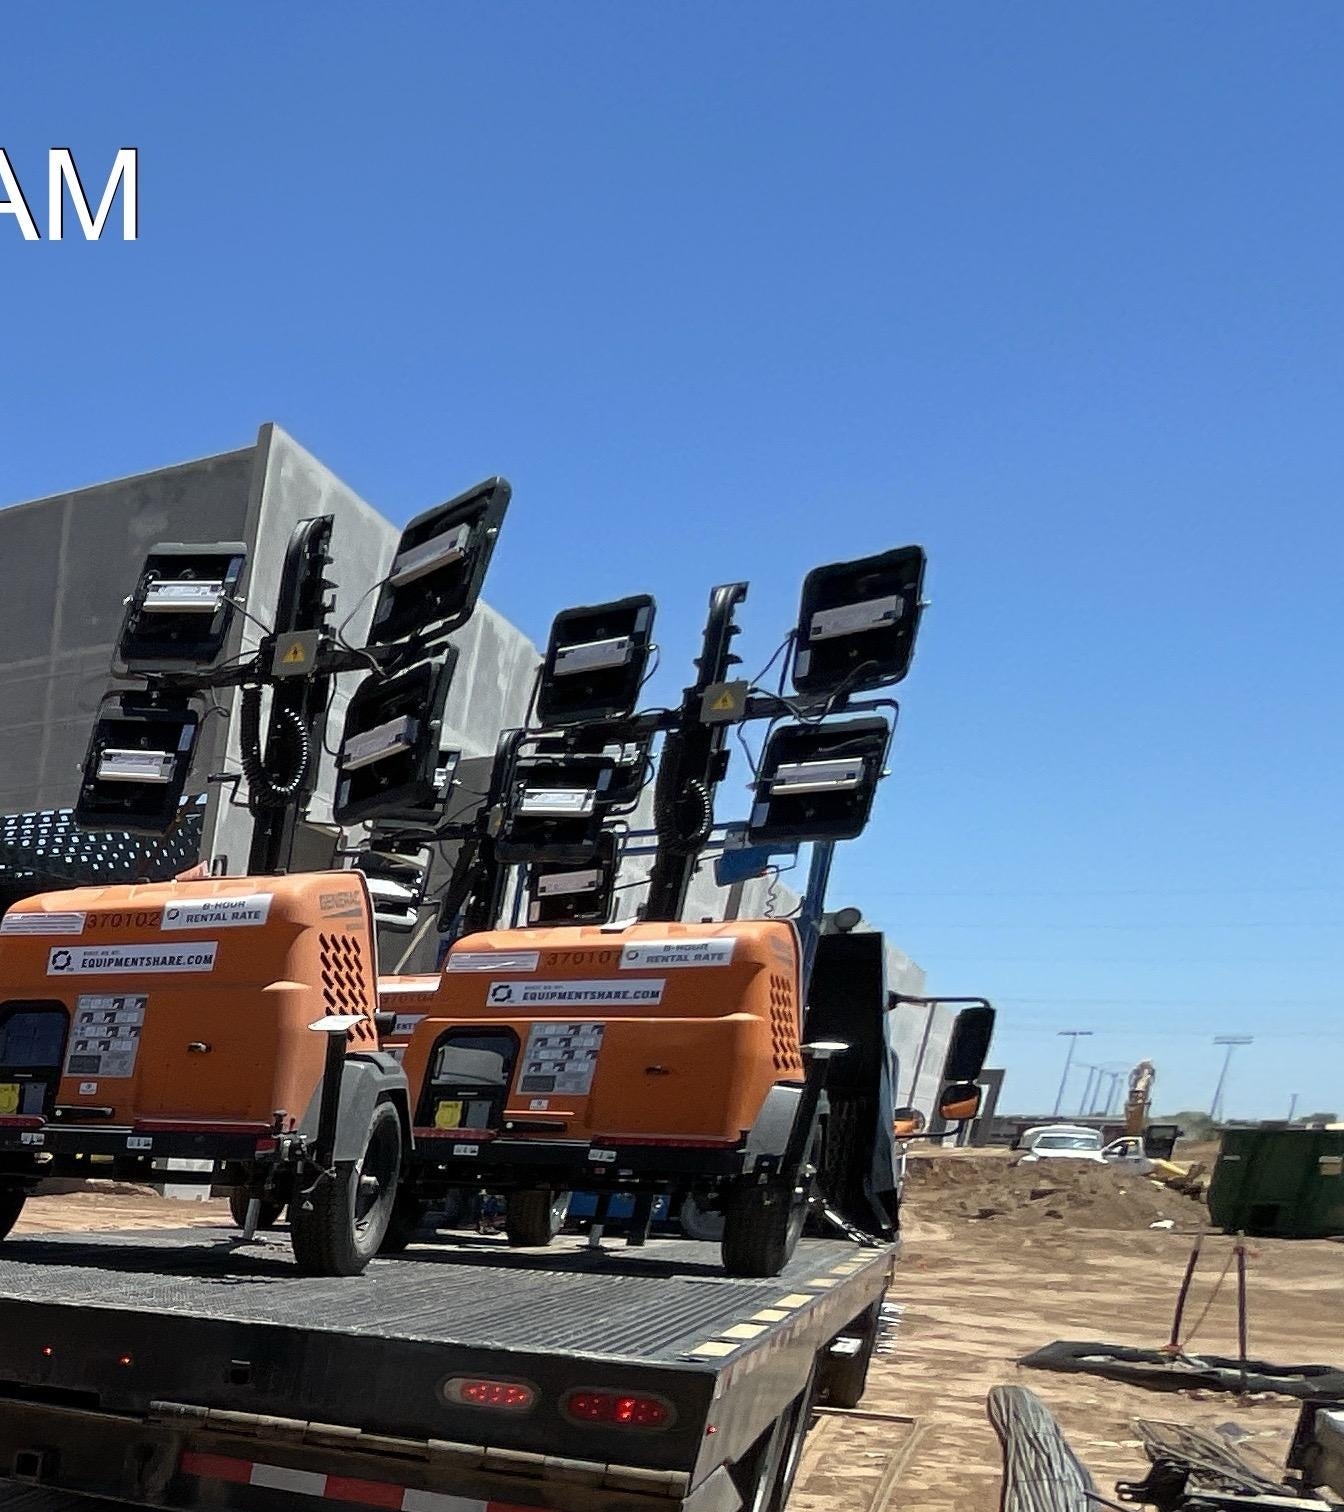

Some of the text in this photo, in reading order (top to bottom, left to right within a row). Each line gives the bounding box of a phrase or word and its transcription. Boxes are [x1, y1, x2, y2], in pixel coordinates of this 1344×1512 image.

[186, 911, 261, 923] RENTAL RATE
[81, 954, 214, 969] EQUIPMENTSHARE.COM
